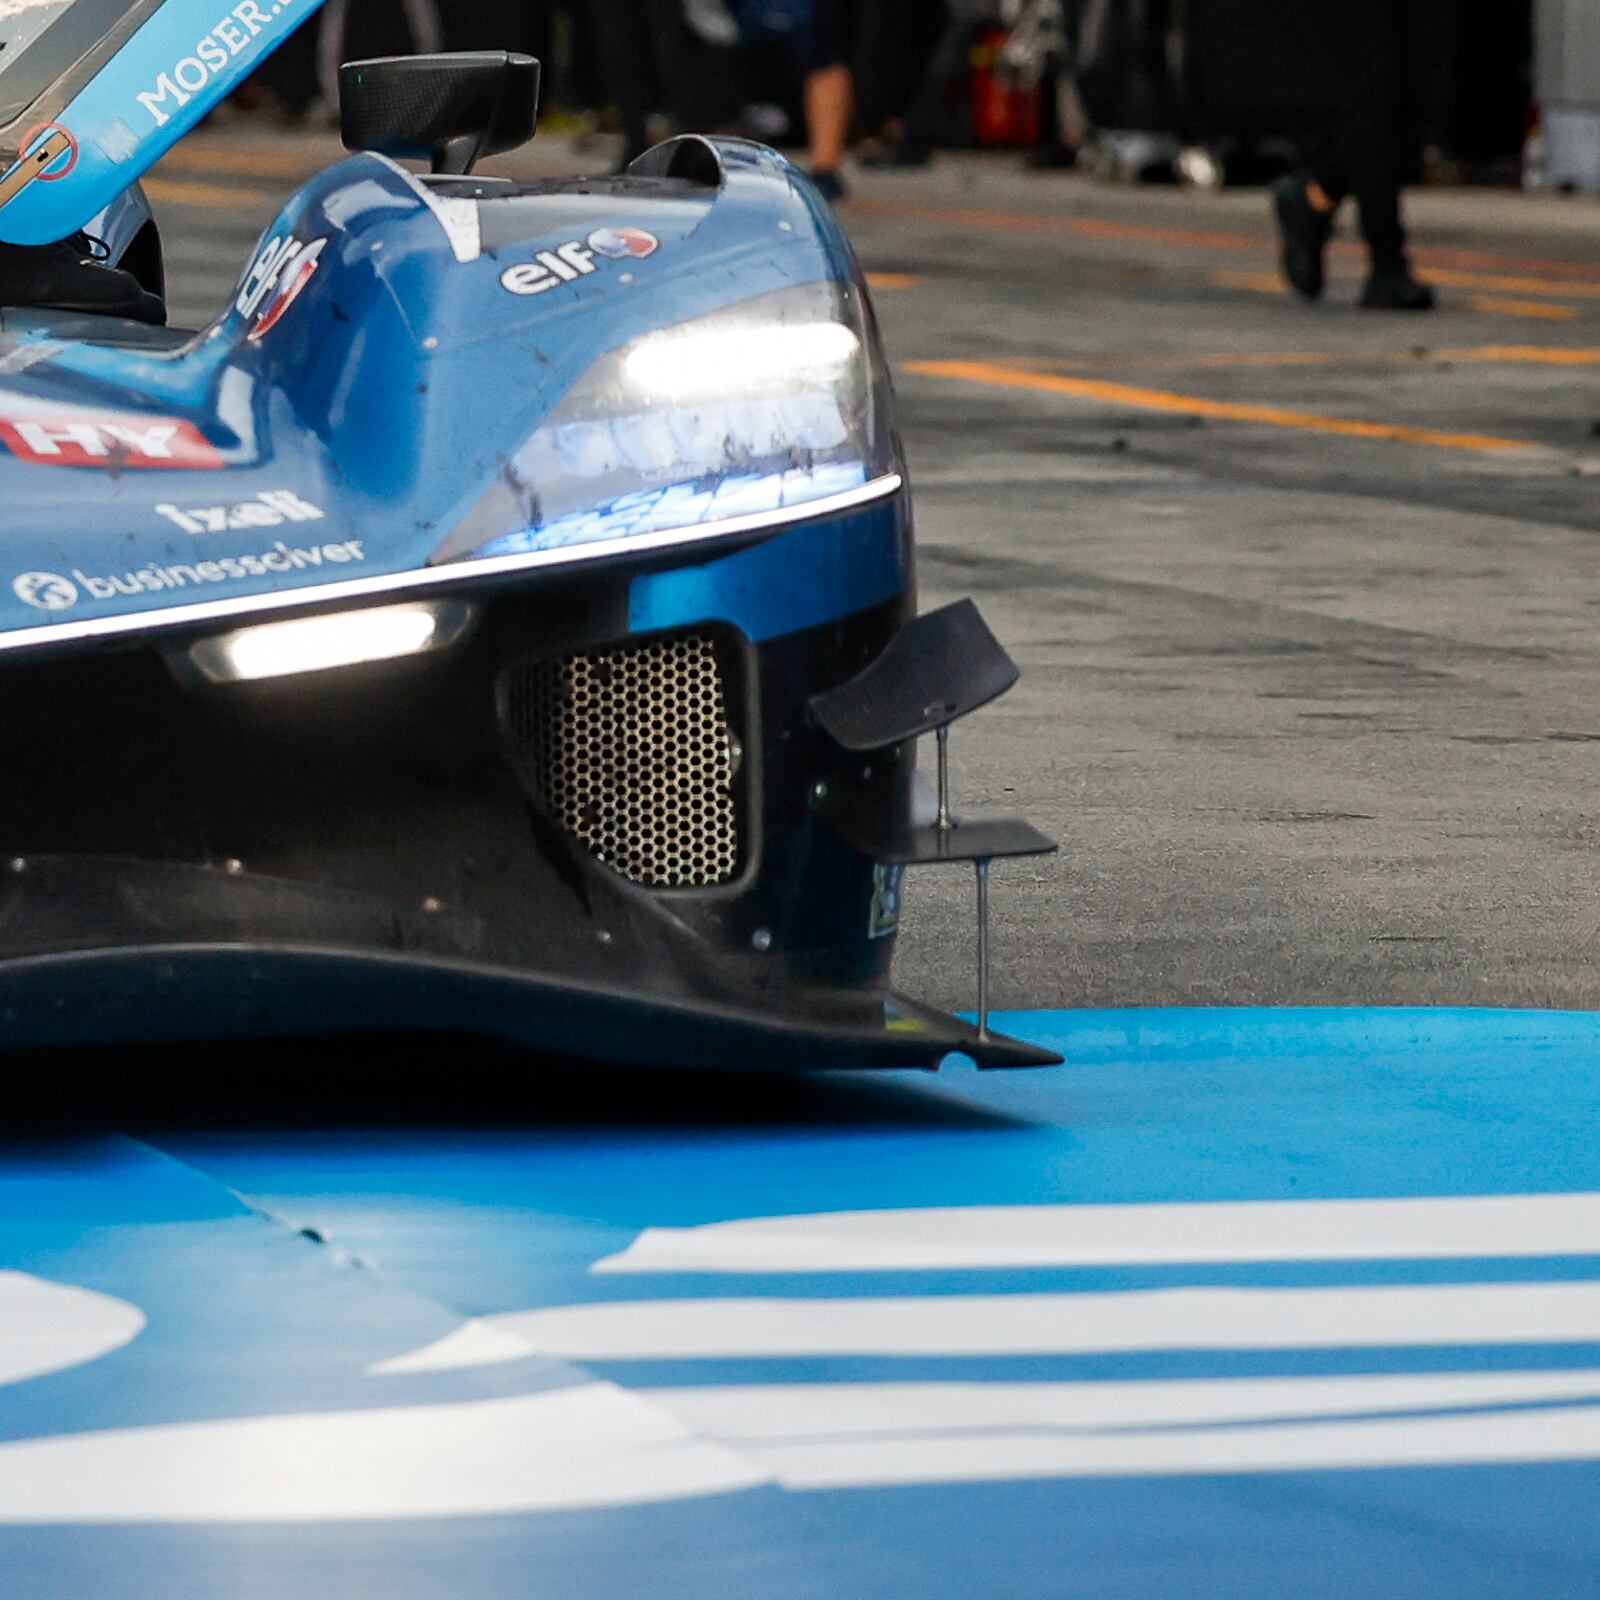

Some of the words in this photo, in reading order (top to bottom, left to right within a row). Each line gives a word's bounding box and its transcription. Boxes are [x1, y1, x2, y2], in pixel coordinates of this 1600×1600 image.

[236, 235, 303, 320] elf
[500, 242, 595, 297] elf
[14, 421, 178, 458] HY
[72, 539, 366, 600] businessolver
